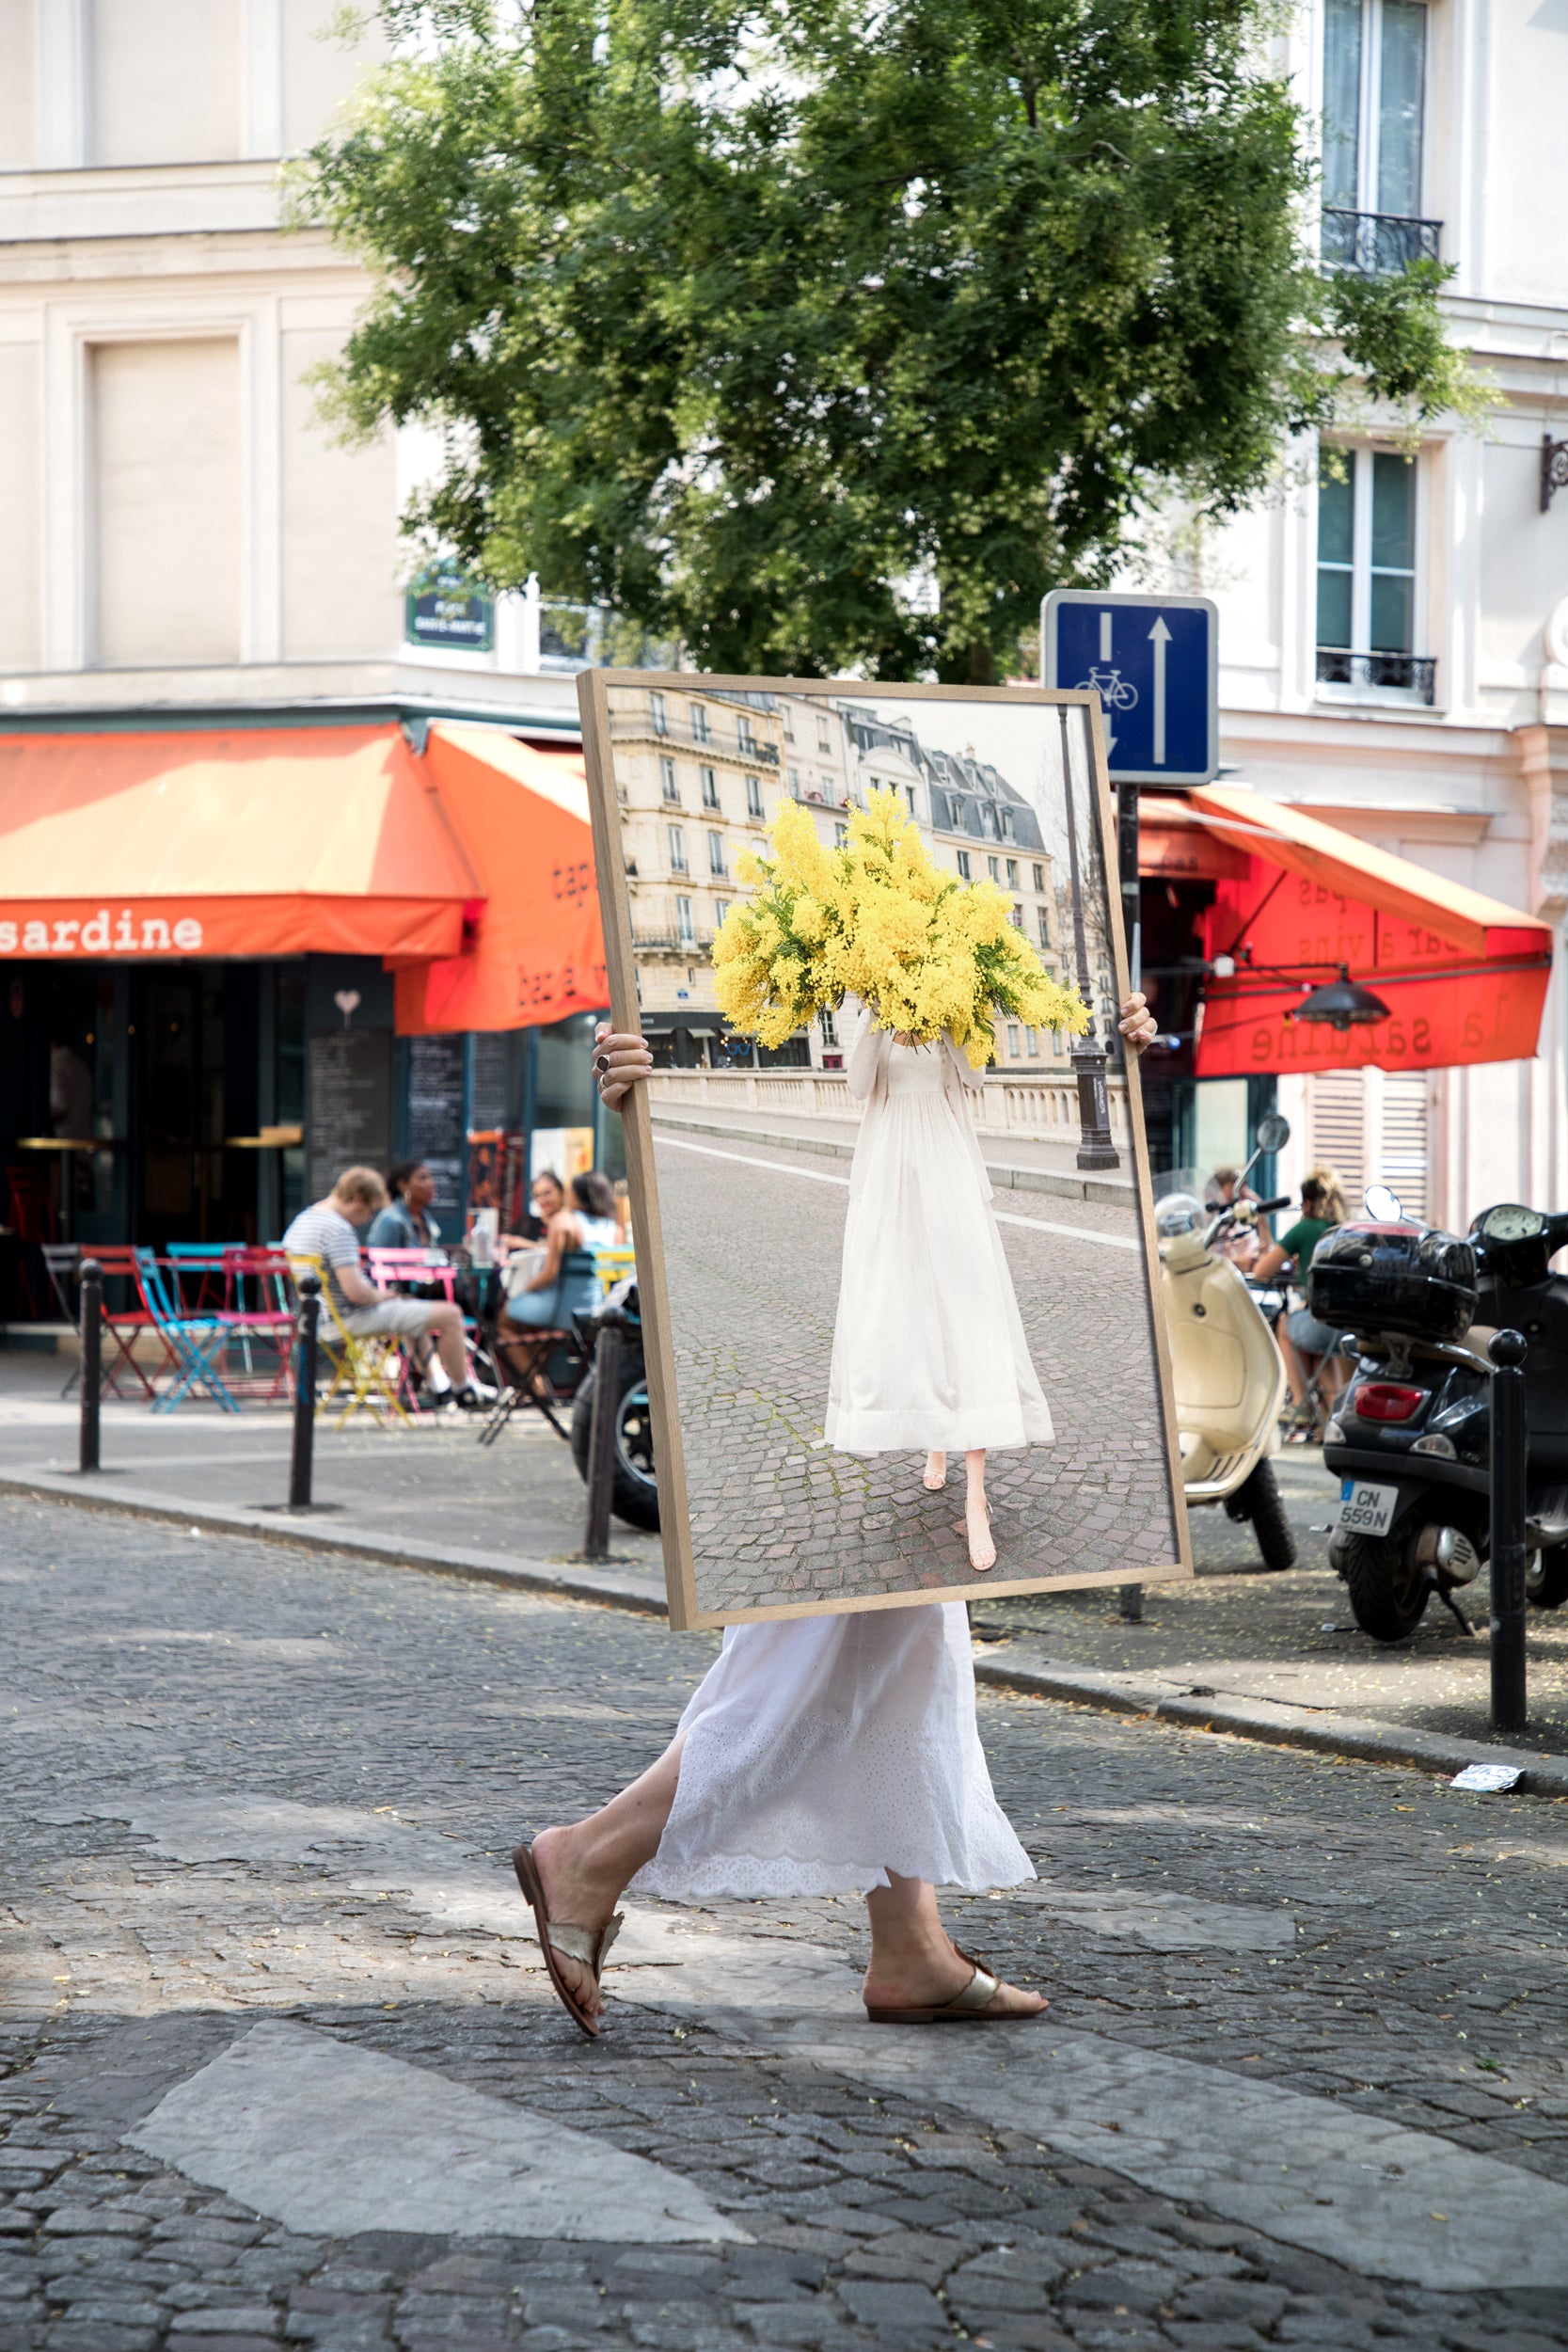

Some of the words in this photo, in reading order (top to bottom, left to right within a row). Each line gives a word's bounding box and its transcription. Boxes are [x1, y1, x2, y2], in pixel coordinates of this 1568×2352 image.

[0, 909, 203, 952] sardine
[1357, 1489, 1381, 1508] CN
[1340, 1506, 1387, 1529] 559N
